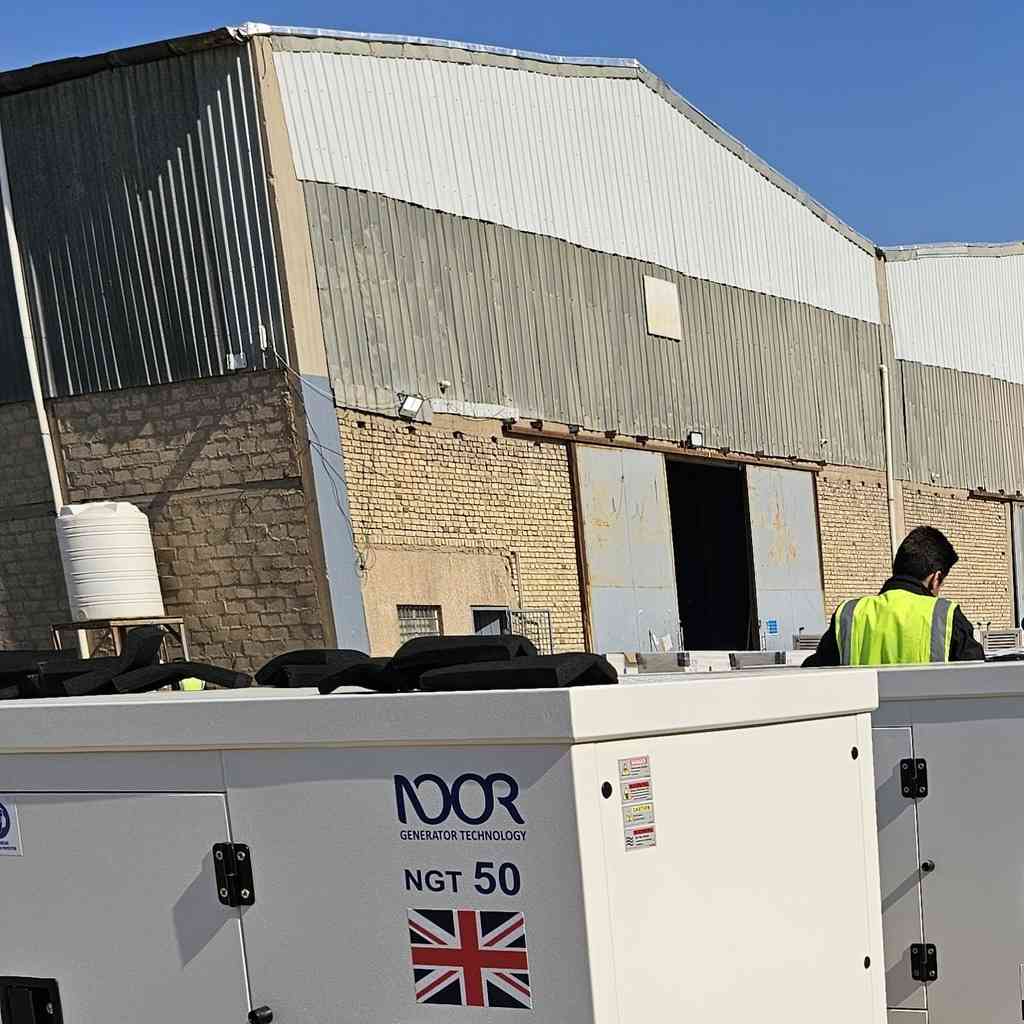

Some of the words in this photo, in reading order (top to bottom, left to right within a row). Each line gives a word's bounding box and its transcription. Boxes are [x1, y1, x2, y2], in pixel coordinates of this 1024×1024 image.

[393, 772, 525, 825] NOOR
[400, 830, 457, 841] GENERATOR
[460, 830, 527, 841] TECHNOLOGY
[404, 869, 462, 893] NGT
[474, 861, 521, 896] 50
